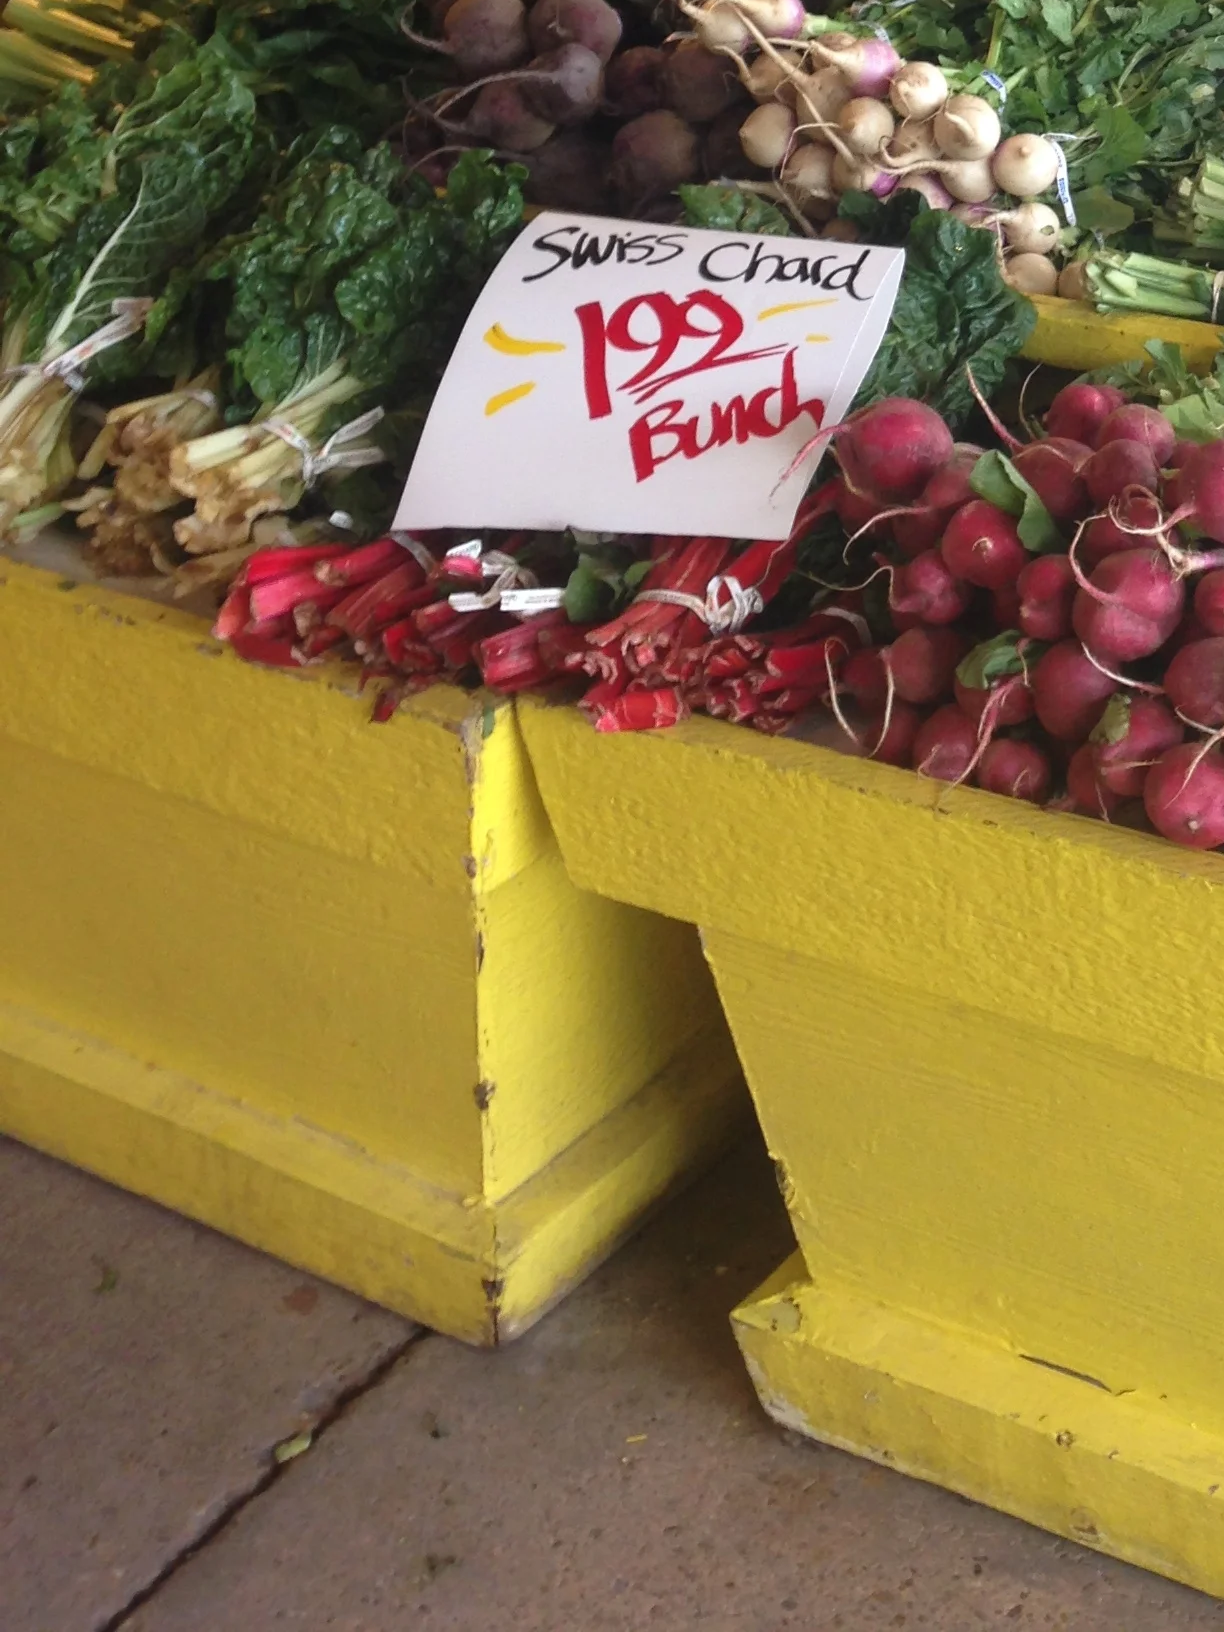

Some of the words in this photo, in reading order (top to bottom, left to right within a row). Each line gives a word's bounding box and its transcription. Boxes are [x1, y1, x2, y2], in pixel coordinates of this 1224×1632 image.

[521, 226, 690, 282] Swiss
[698, 241, 875, 301] Chard
[628, 346, 826, 484] Bunch
